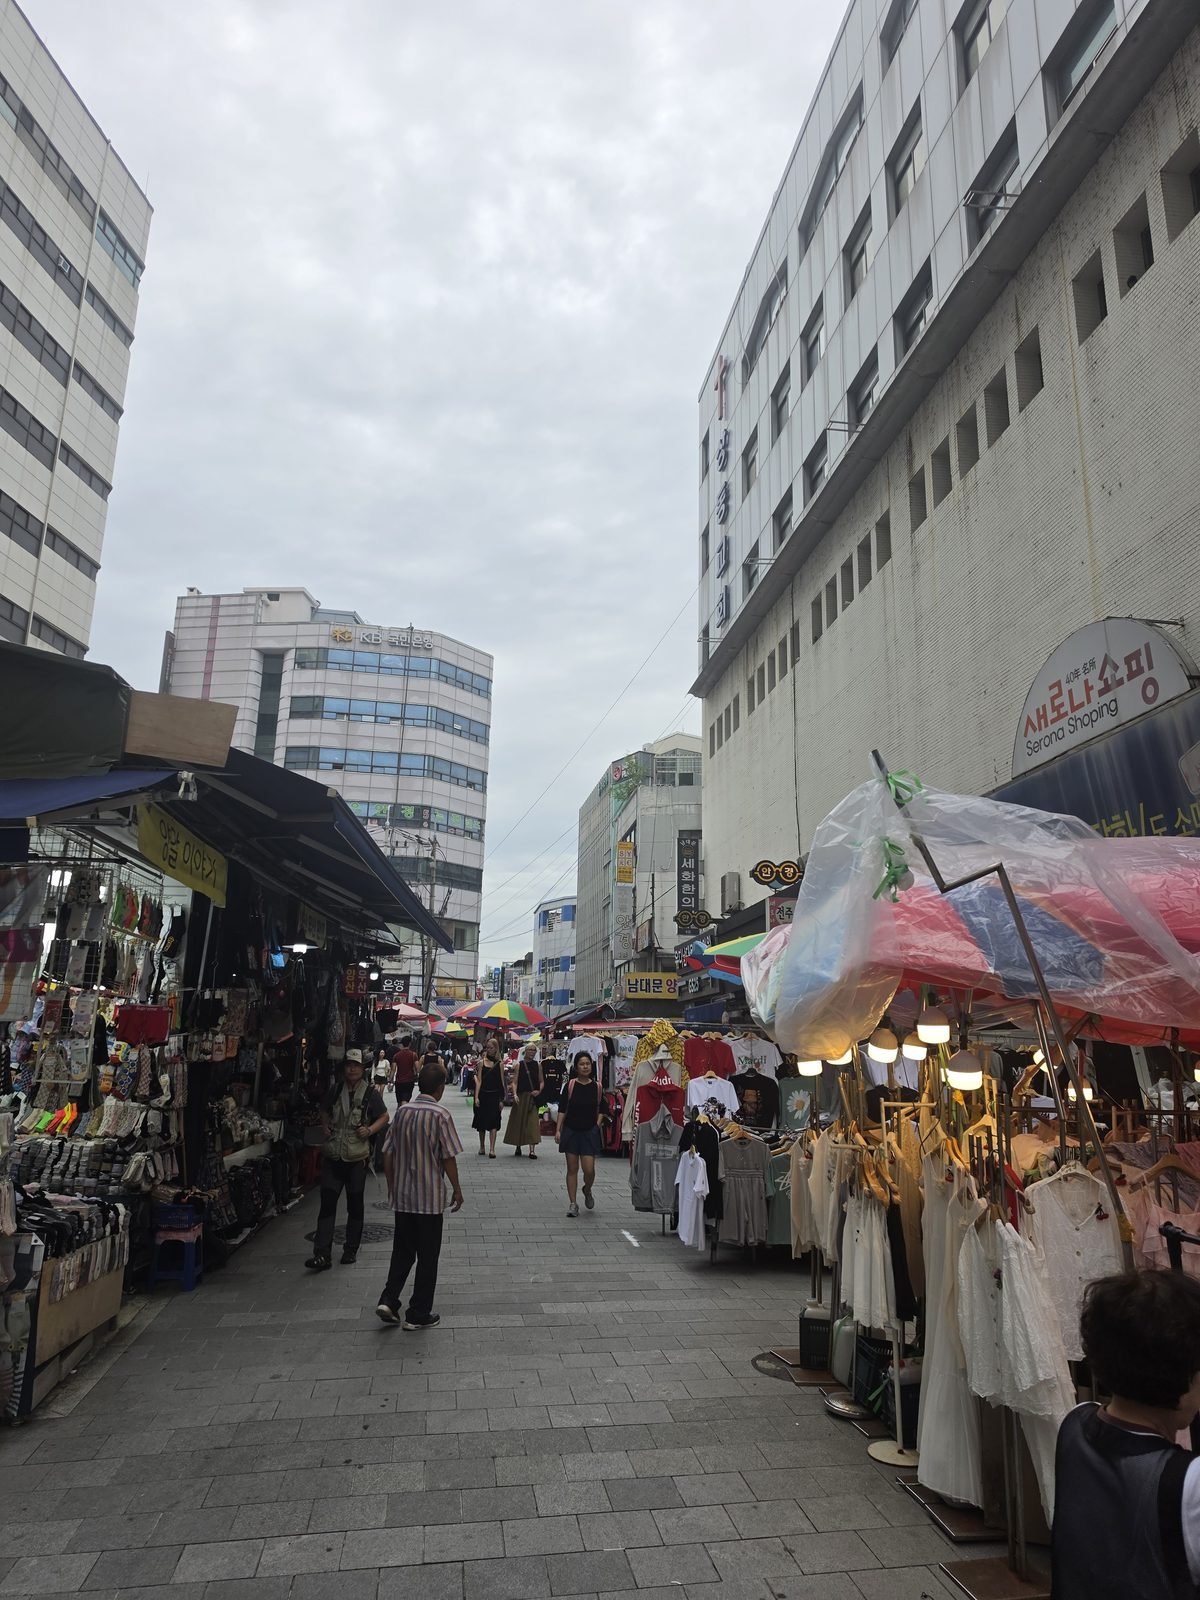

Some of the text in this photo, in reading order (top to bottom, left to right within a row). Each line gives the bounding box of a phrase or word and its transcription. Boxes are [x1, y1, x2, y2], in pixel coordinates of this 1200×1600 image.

[360, 631, 434, 649] KB 국민은행
[1025, 697, 1119, 757] Serona Shoping
[183, 841, 217, 888] 이야기
[761, 866, 794, 879] 안경
[681, 857, 696, 909] 세화한의
[681, 913, 707, 924] 안경
[614, 914, 631, 950] 안경
[627, 978, 663, 993] 남대문
[738, 1055, 767, 1065] Mardi
